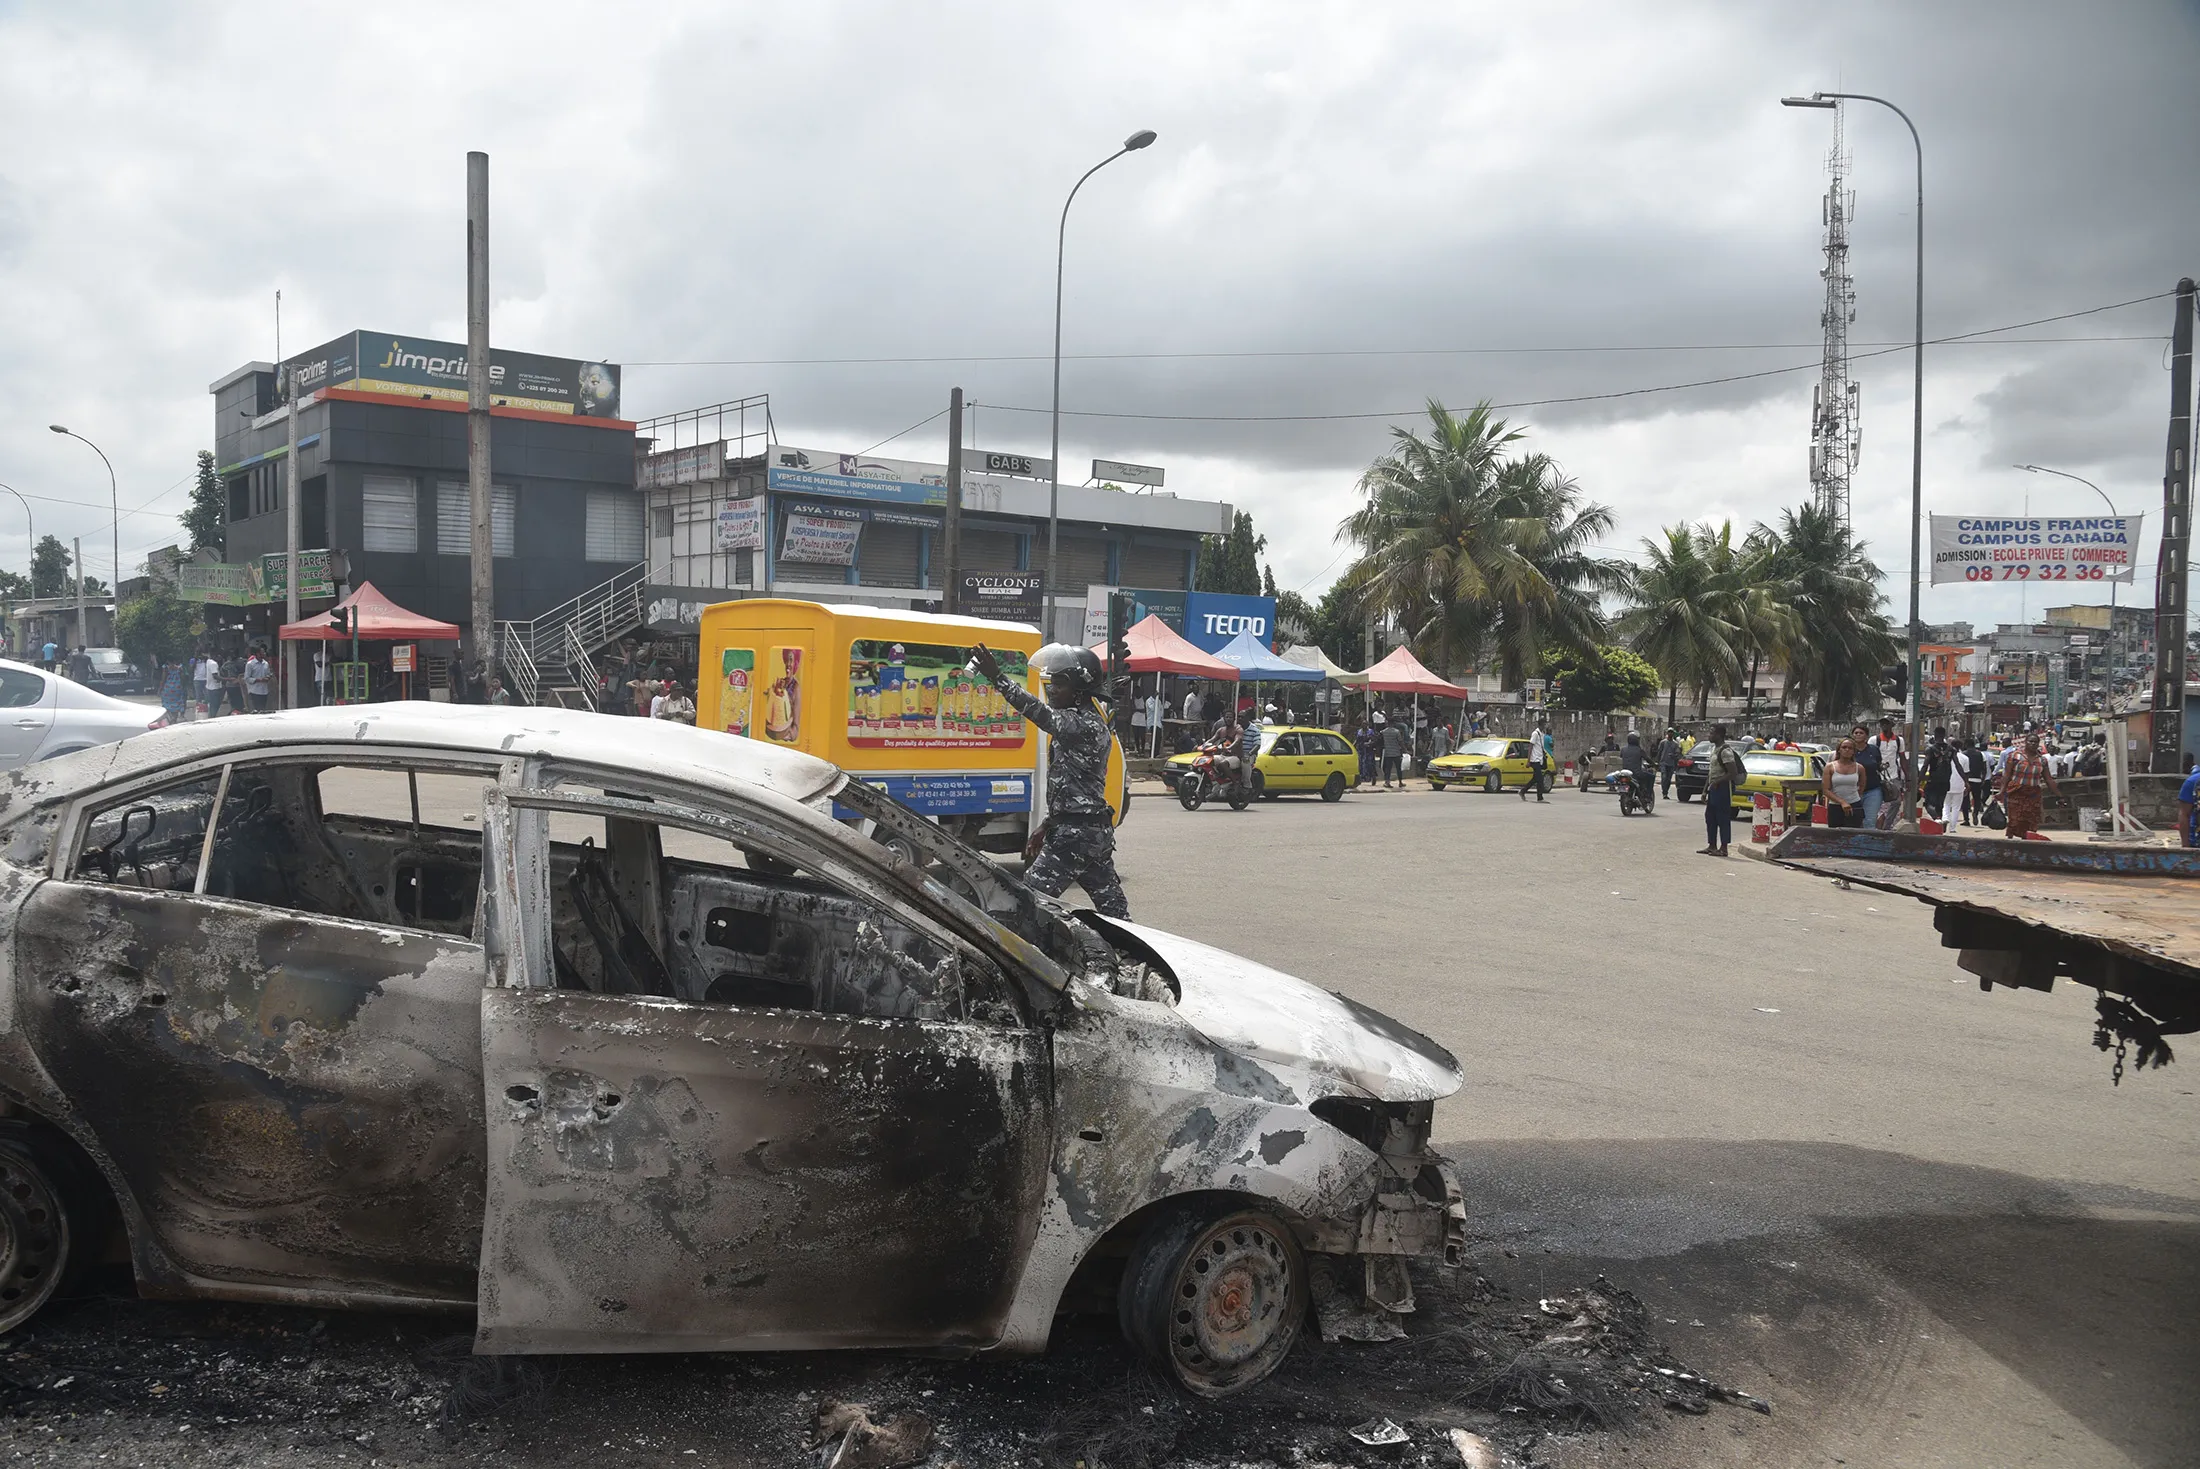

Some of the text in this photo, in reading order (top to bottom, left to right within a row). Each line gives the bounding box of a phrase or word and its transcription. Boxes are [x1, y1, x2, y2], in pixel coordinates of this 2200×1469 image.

[375, 383, 406, 393] VOTRE
[514, 399, 531, 408] TOP
[533, 401, 570, 412] QUALITE
[991, 455, 1033, 472] GAB'S
[776, 472, 902, 493] VENTE DE MATERIEL INFORMATIQUE
[857, 470, 902, 481] ASYA-TECH
[794, 504, 822, 514] ASYA
[832, 509, 860, 518] TECH
[1958, 519, 2126, 531] CAMPUS FRANCE
[1958, 532, 2128, 545] CAMPUS CANADA
[1936, 550, 1987, 563] ADMISSION
[1994, 549, 2027, 562] ECOLE
[2028, 548, 2065, 561] PRIVEE
[2072, 549, 2127, 563] COMMERCE
[1965, 564, 2103, 581] 08 79 32 36
[965, 577, 1040, 588] CYCLONE
[1203, 614, 1266, 637] TECNO
